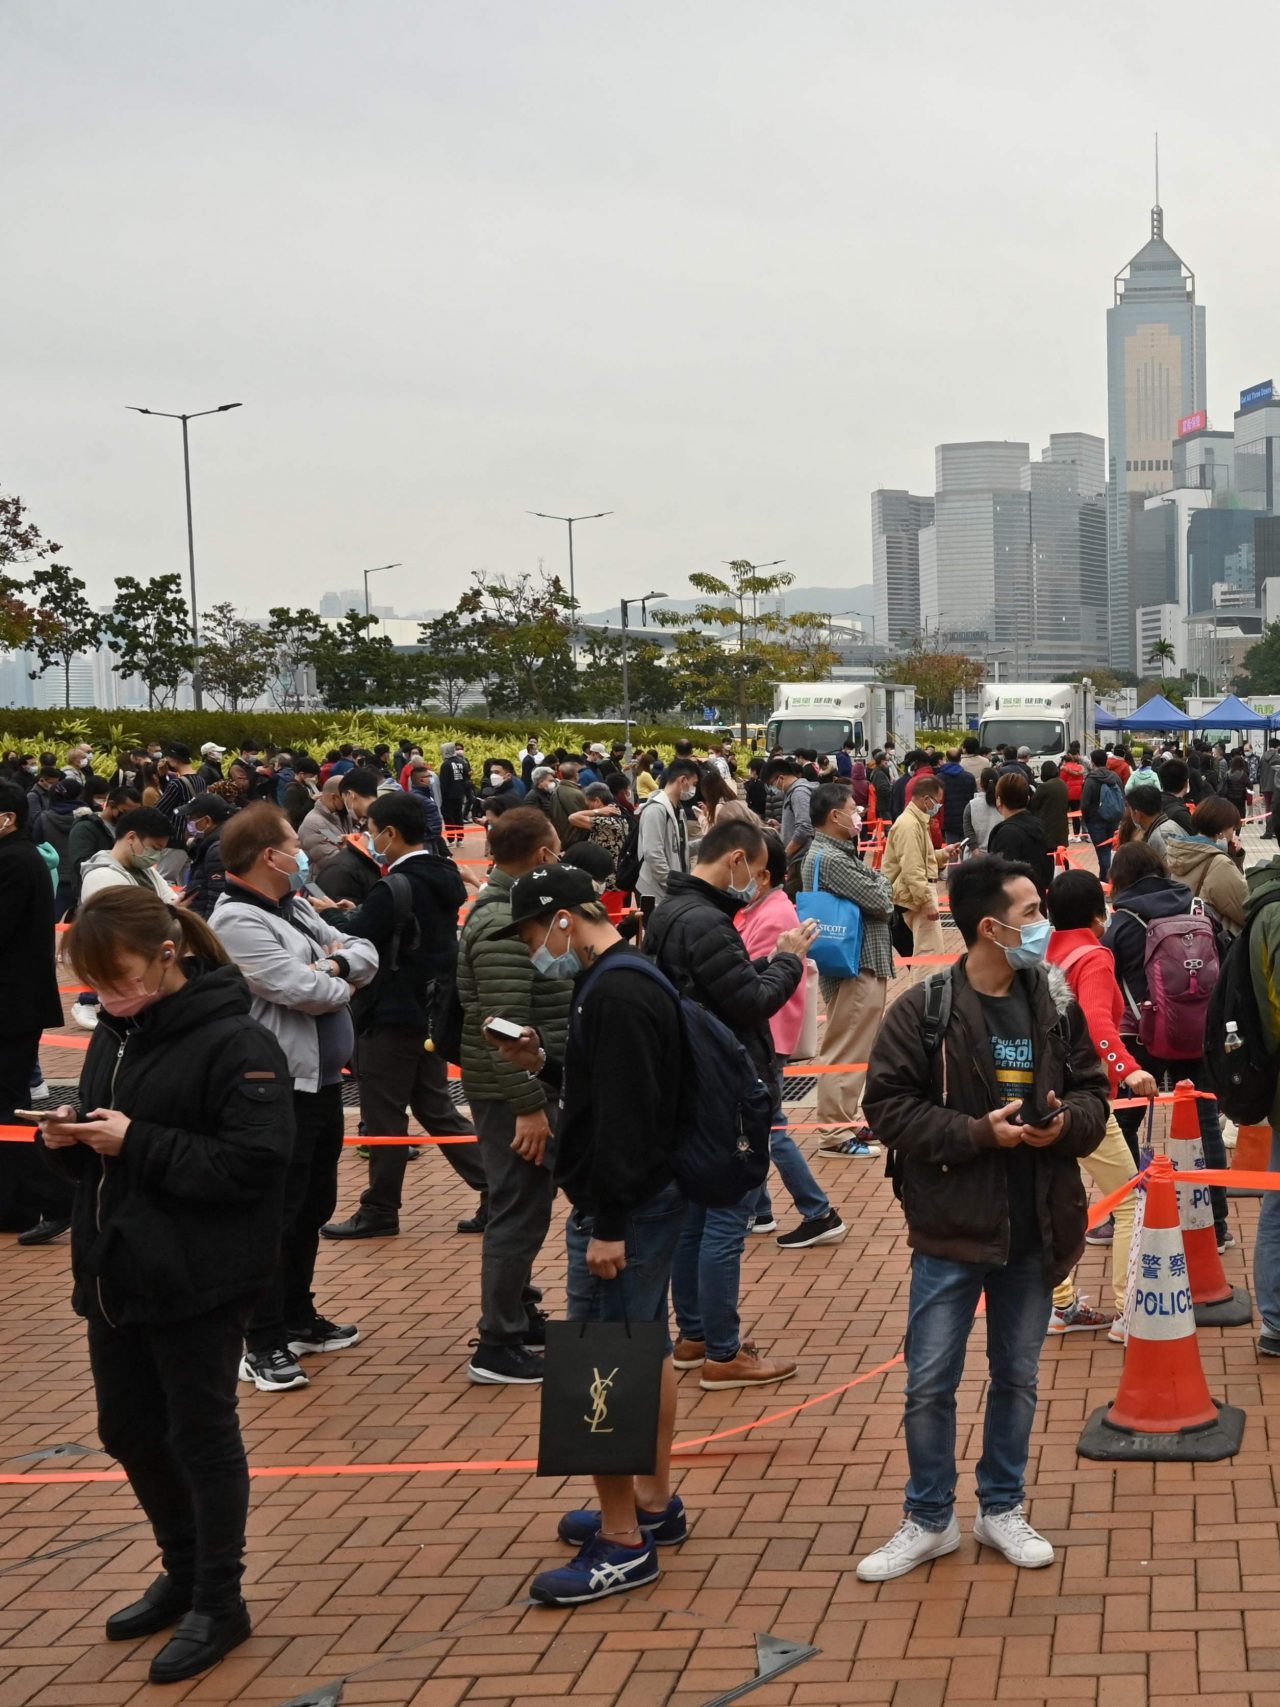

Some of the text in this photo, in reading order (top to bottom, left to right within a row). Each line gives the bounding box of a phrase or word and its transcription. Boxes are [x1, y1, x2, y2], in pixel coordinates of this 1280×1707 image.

[818, 923, 847, 933] STCOTT
[1141, 1253, 1186, 1279] 警察
[1135, 1287, 1193, 1316] POLICE
[583, 1367, 620, 1433] YSL
